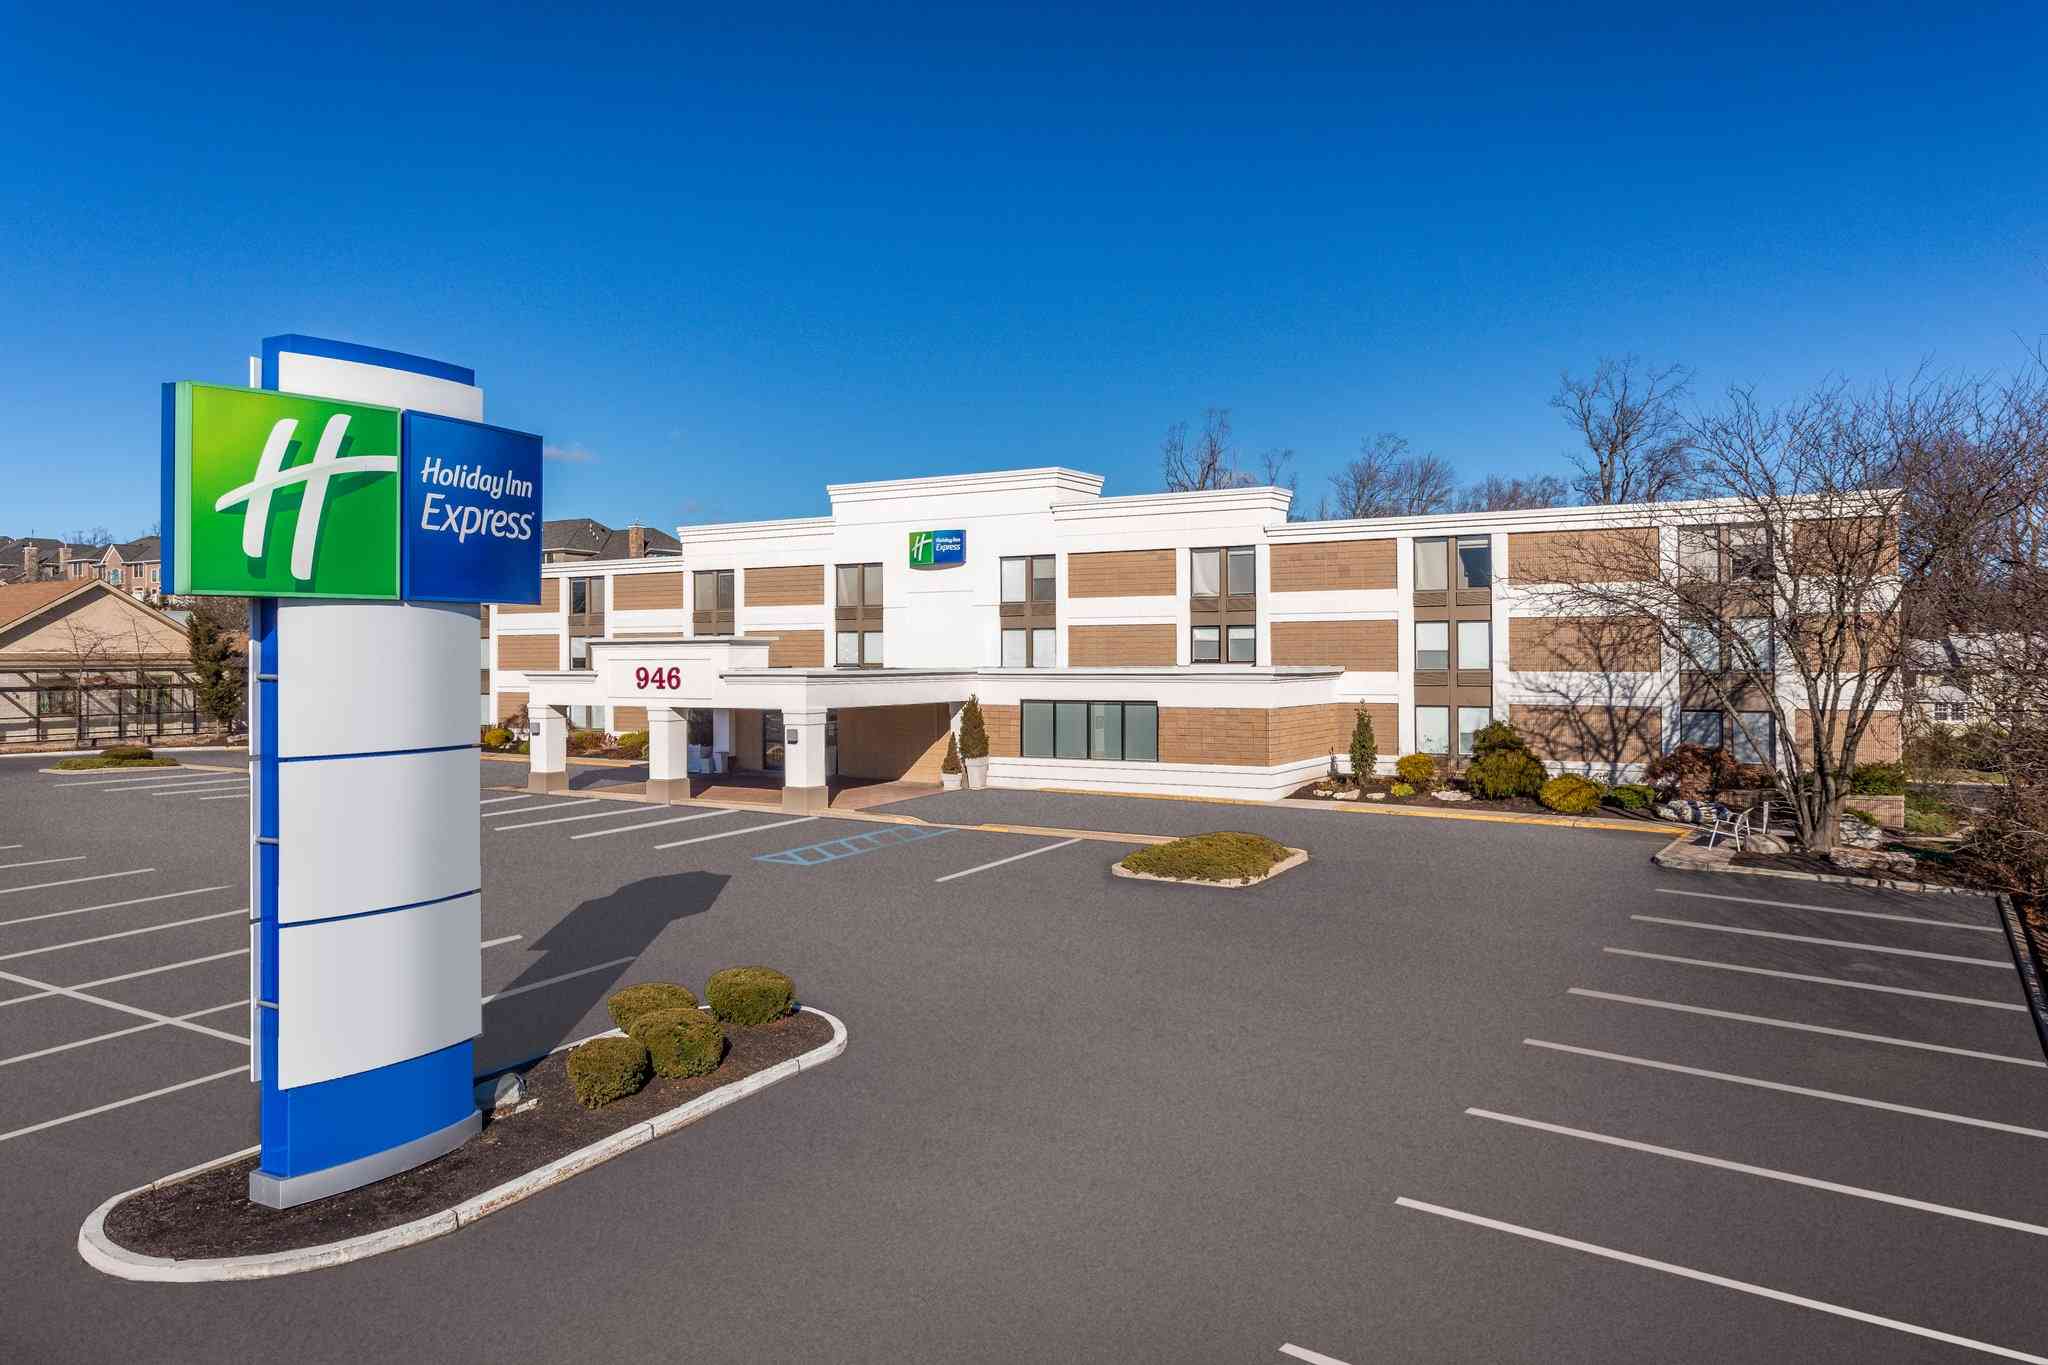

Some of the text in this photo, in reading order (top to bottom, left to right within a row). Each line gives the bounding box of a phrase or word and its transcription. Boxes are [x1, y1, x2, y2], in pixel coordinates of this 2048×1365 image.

[421, 456, 533, 499] Holiday Inn
[421, 493, 534, 544] Express
[635, 667, 682, 690] 946
